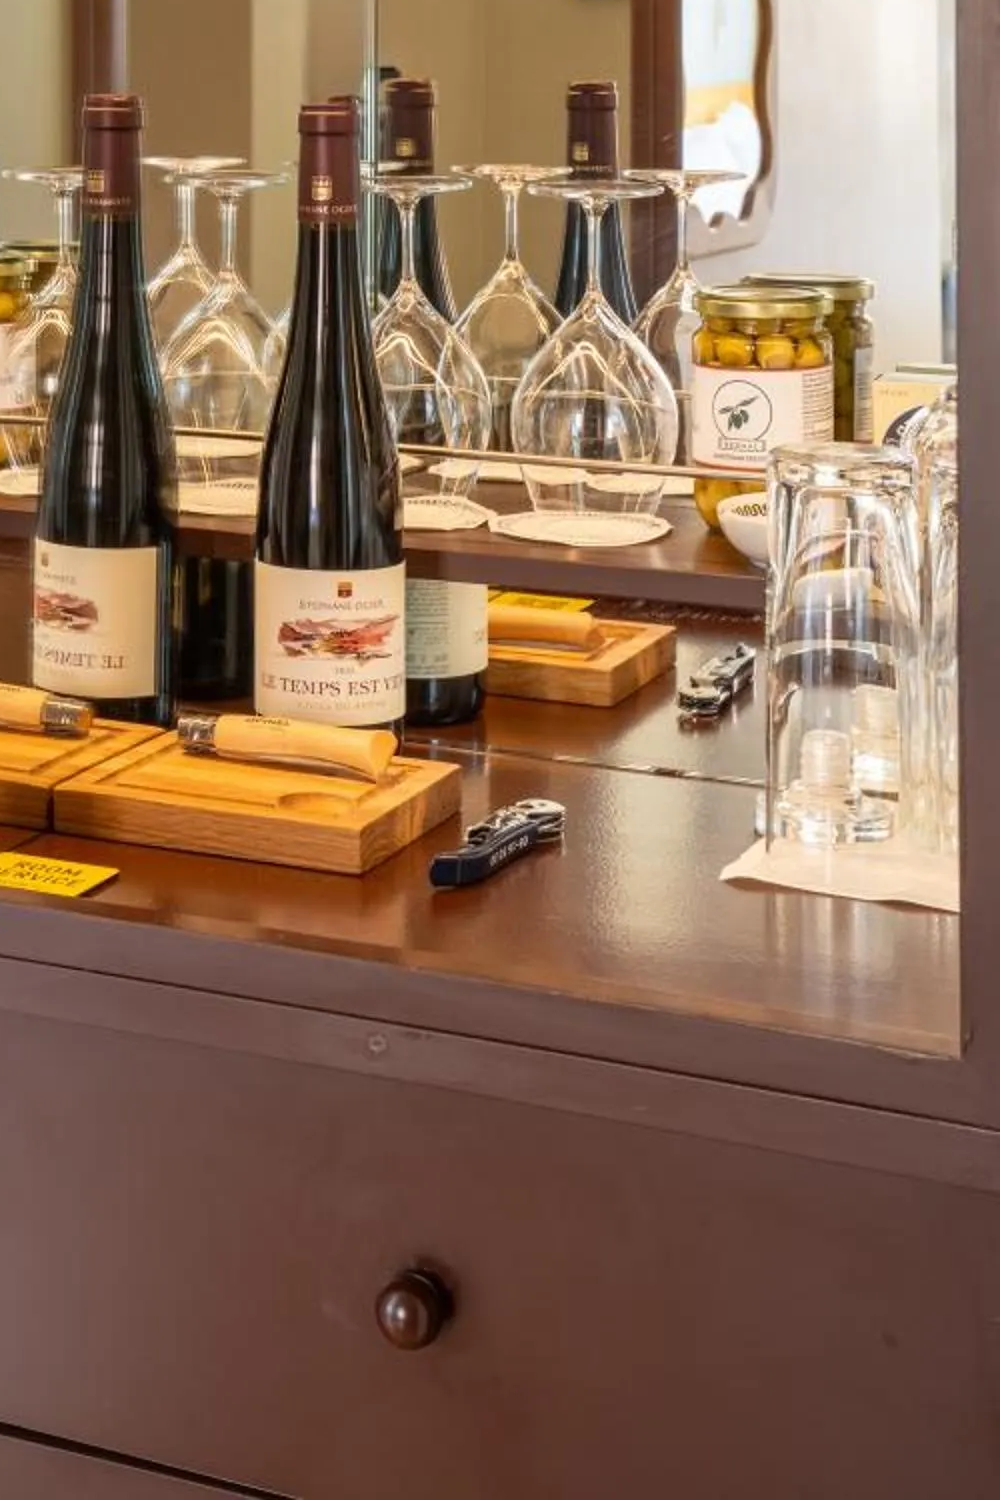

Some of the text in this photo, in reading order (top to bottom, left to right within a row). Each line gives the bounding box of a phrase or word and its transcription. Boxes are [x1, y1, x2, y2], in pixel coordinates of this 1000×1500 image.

[262, 673, 277, 689] LE
[280, 677, 340, 697] TEMPS
[348, 679, 378, 696] EST
[12, 860, 83, 877] ROOM
